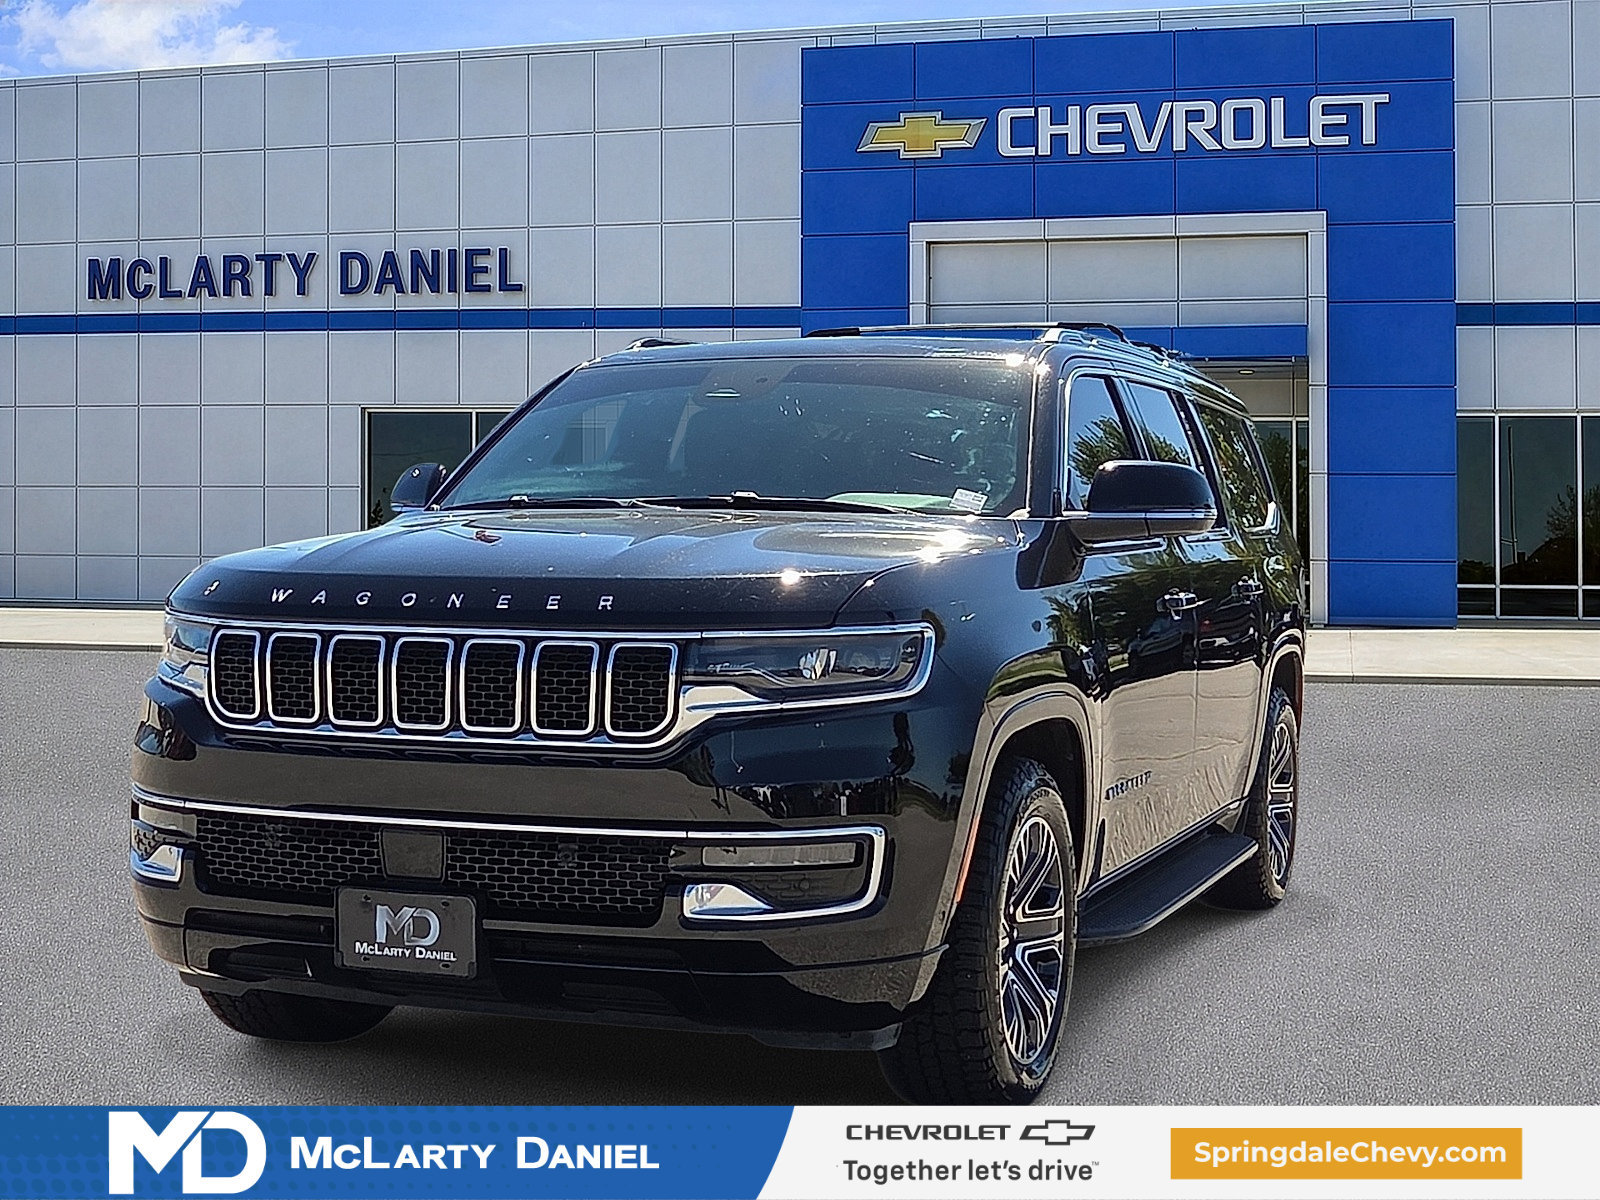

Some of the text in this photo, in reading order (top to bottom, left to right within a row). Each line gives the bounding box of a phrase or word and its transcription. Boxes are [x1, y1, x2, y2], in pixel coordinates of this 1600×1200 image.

[996, 94, 1390, 157] CHEVROLET
[87, 246, 526, 301] MCLARTY DANIEL
[271, 587, 615, 611] WAGONEER
[375, 904, 440, 946] MD
